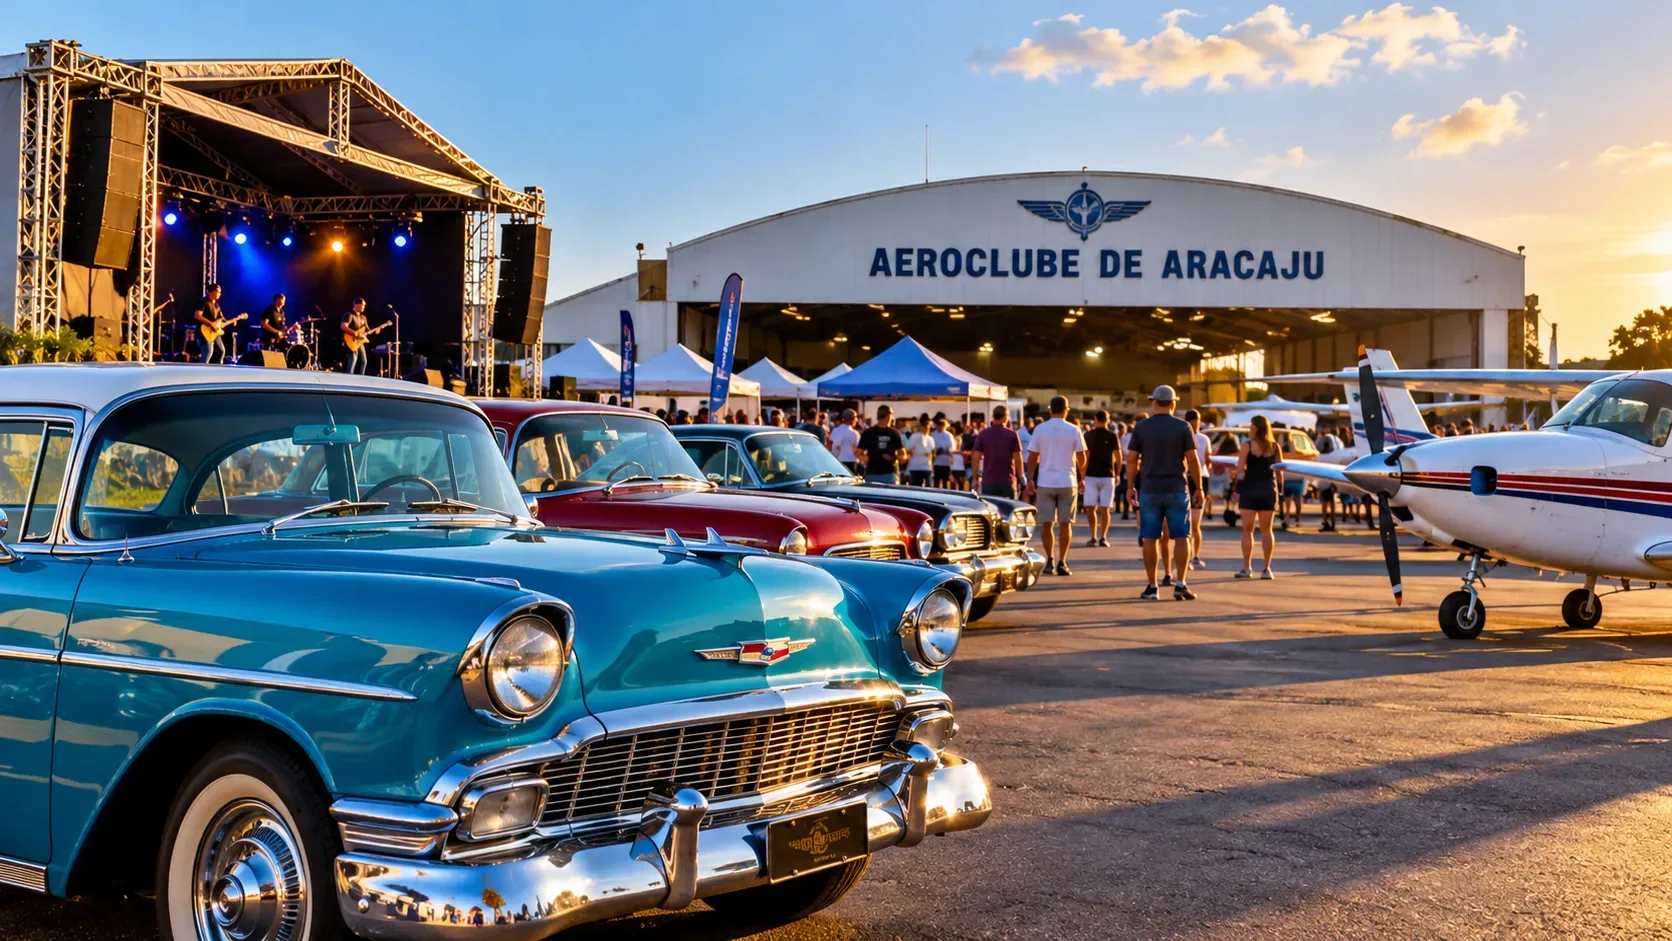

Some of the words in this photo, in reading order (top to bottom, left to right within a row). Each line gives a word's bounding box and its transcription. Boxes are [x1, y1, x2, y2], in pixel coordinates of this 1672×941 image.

[868, 247, 1080, 279] AEROCLUBE
[1099, 248, 1143, 279] DE
[1160, 249, 1325, 281] ARACAJU
